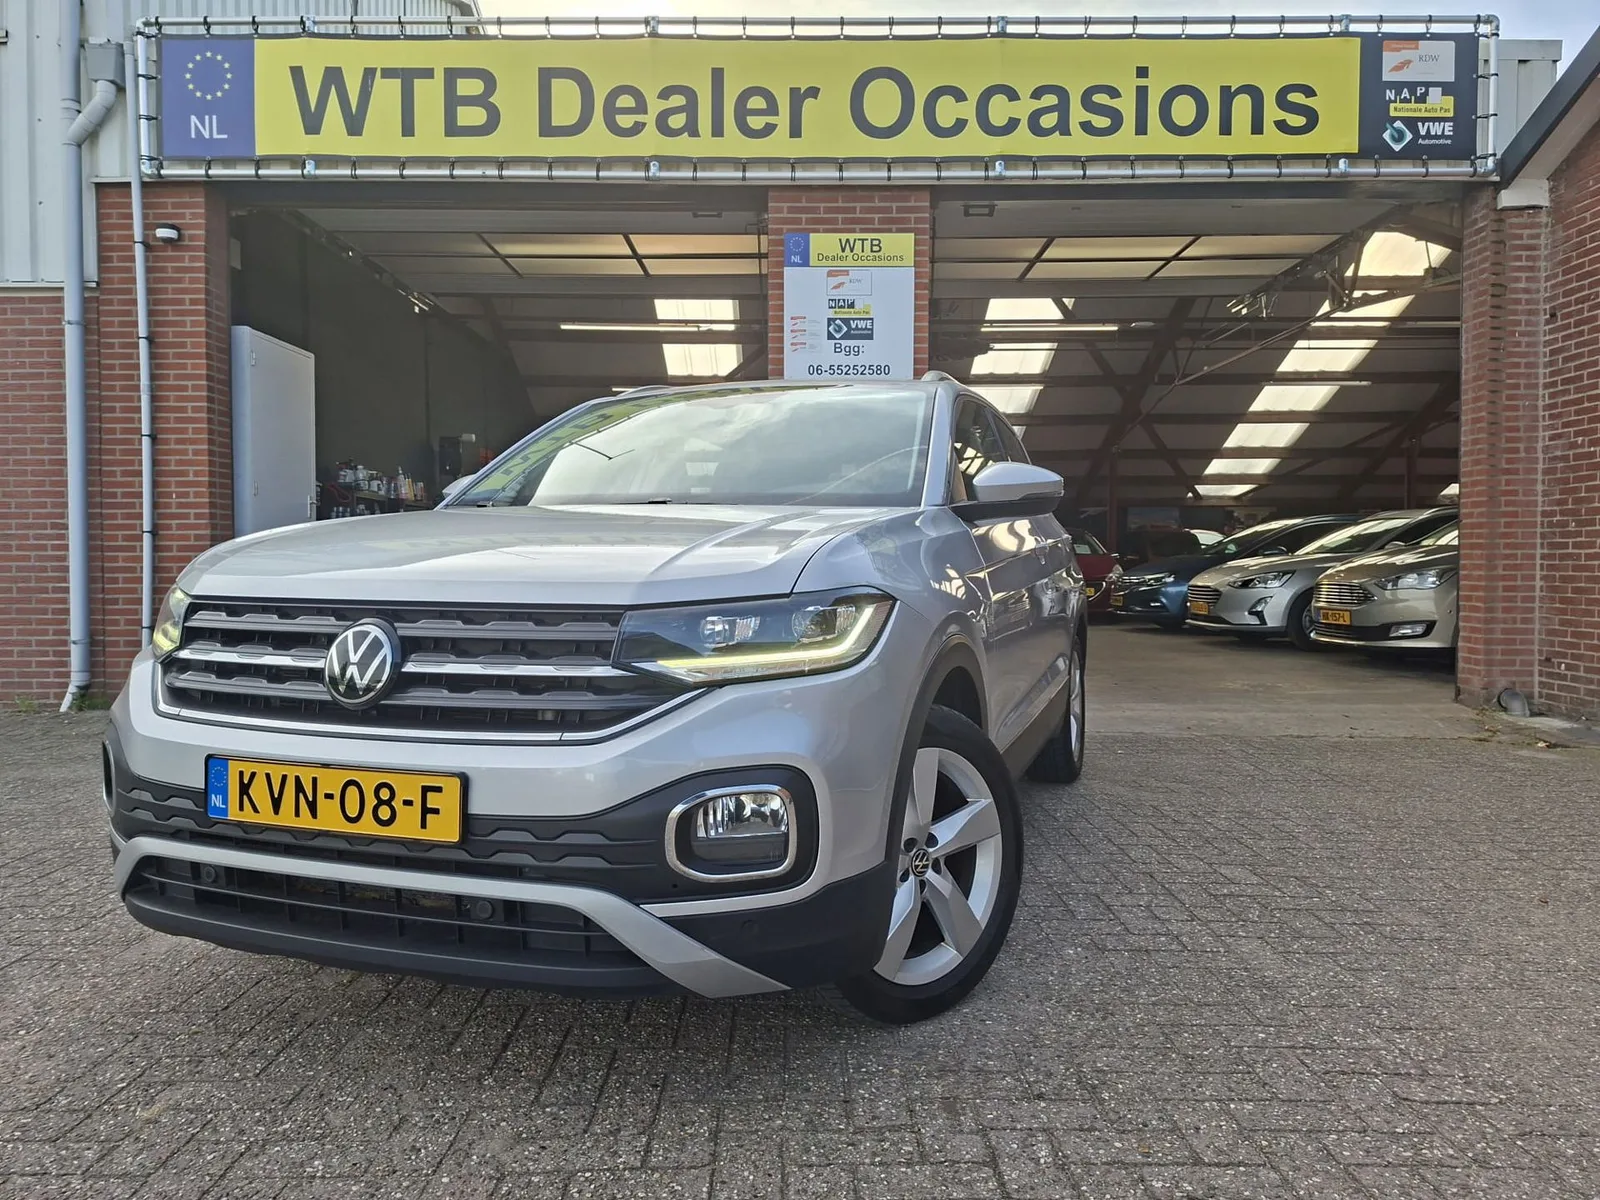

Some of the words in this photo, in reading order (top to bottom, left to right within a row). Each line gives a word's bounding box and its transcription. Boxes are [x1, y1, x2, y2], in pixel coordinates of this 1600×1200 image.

[1418, 54, 1440, 63] RDW
[289, 66, 501, 138] WTB
[537, 66, 820, 139] Dealer
[849, 66, 1320, 140] Occasions
[1393, 106, 1423, 114] Nationale
[1424, 106, 1438, 114] Auto
[190, 115, 228, 140] NL
[1417, 122, 1454, 136] VWE
[838, 238, 883, 254] WTB
[790, 256, 803, 264] NL
[817, 253, 848, 262] Dealer
[852, 253, 904, 262] Occasions
[850, 319, 873, 329] VWE
[833, 342, 865, 357] Bgg:
[807, 364, 891, 376] 06-55252580
[211, 794, 227, 809] NL
[238, 769, 444, 830] KVN-08-F
